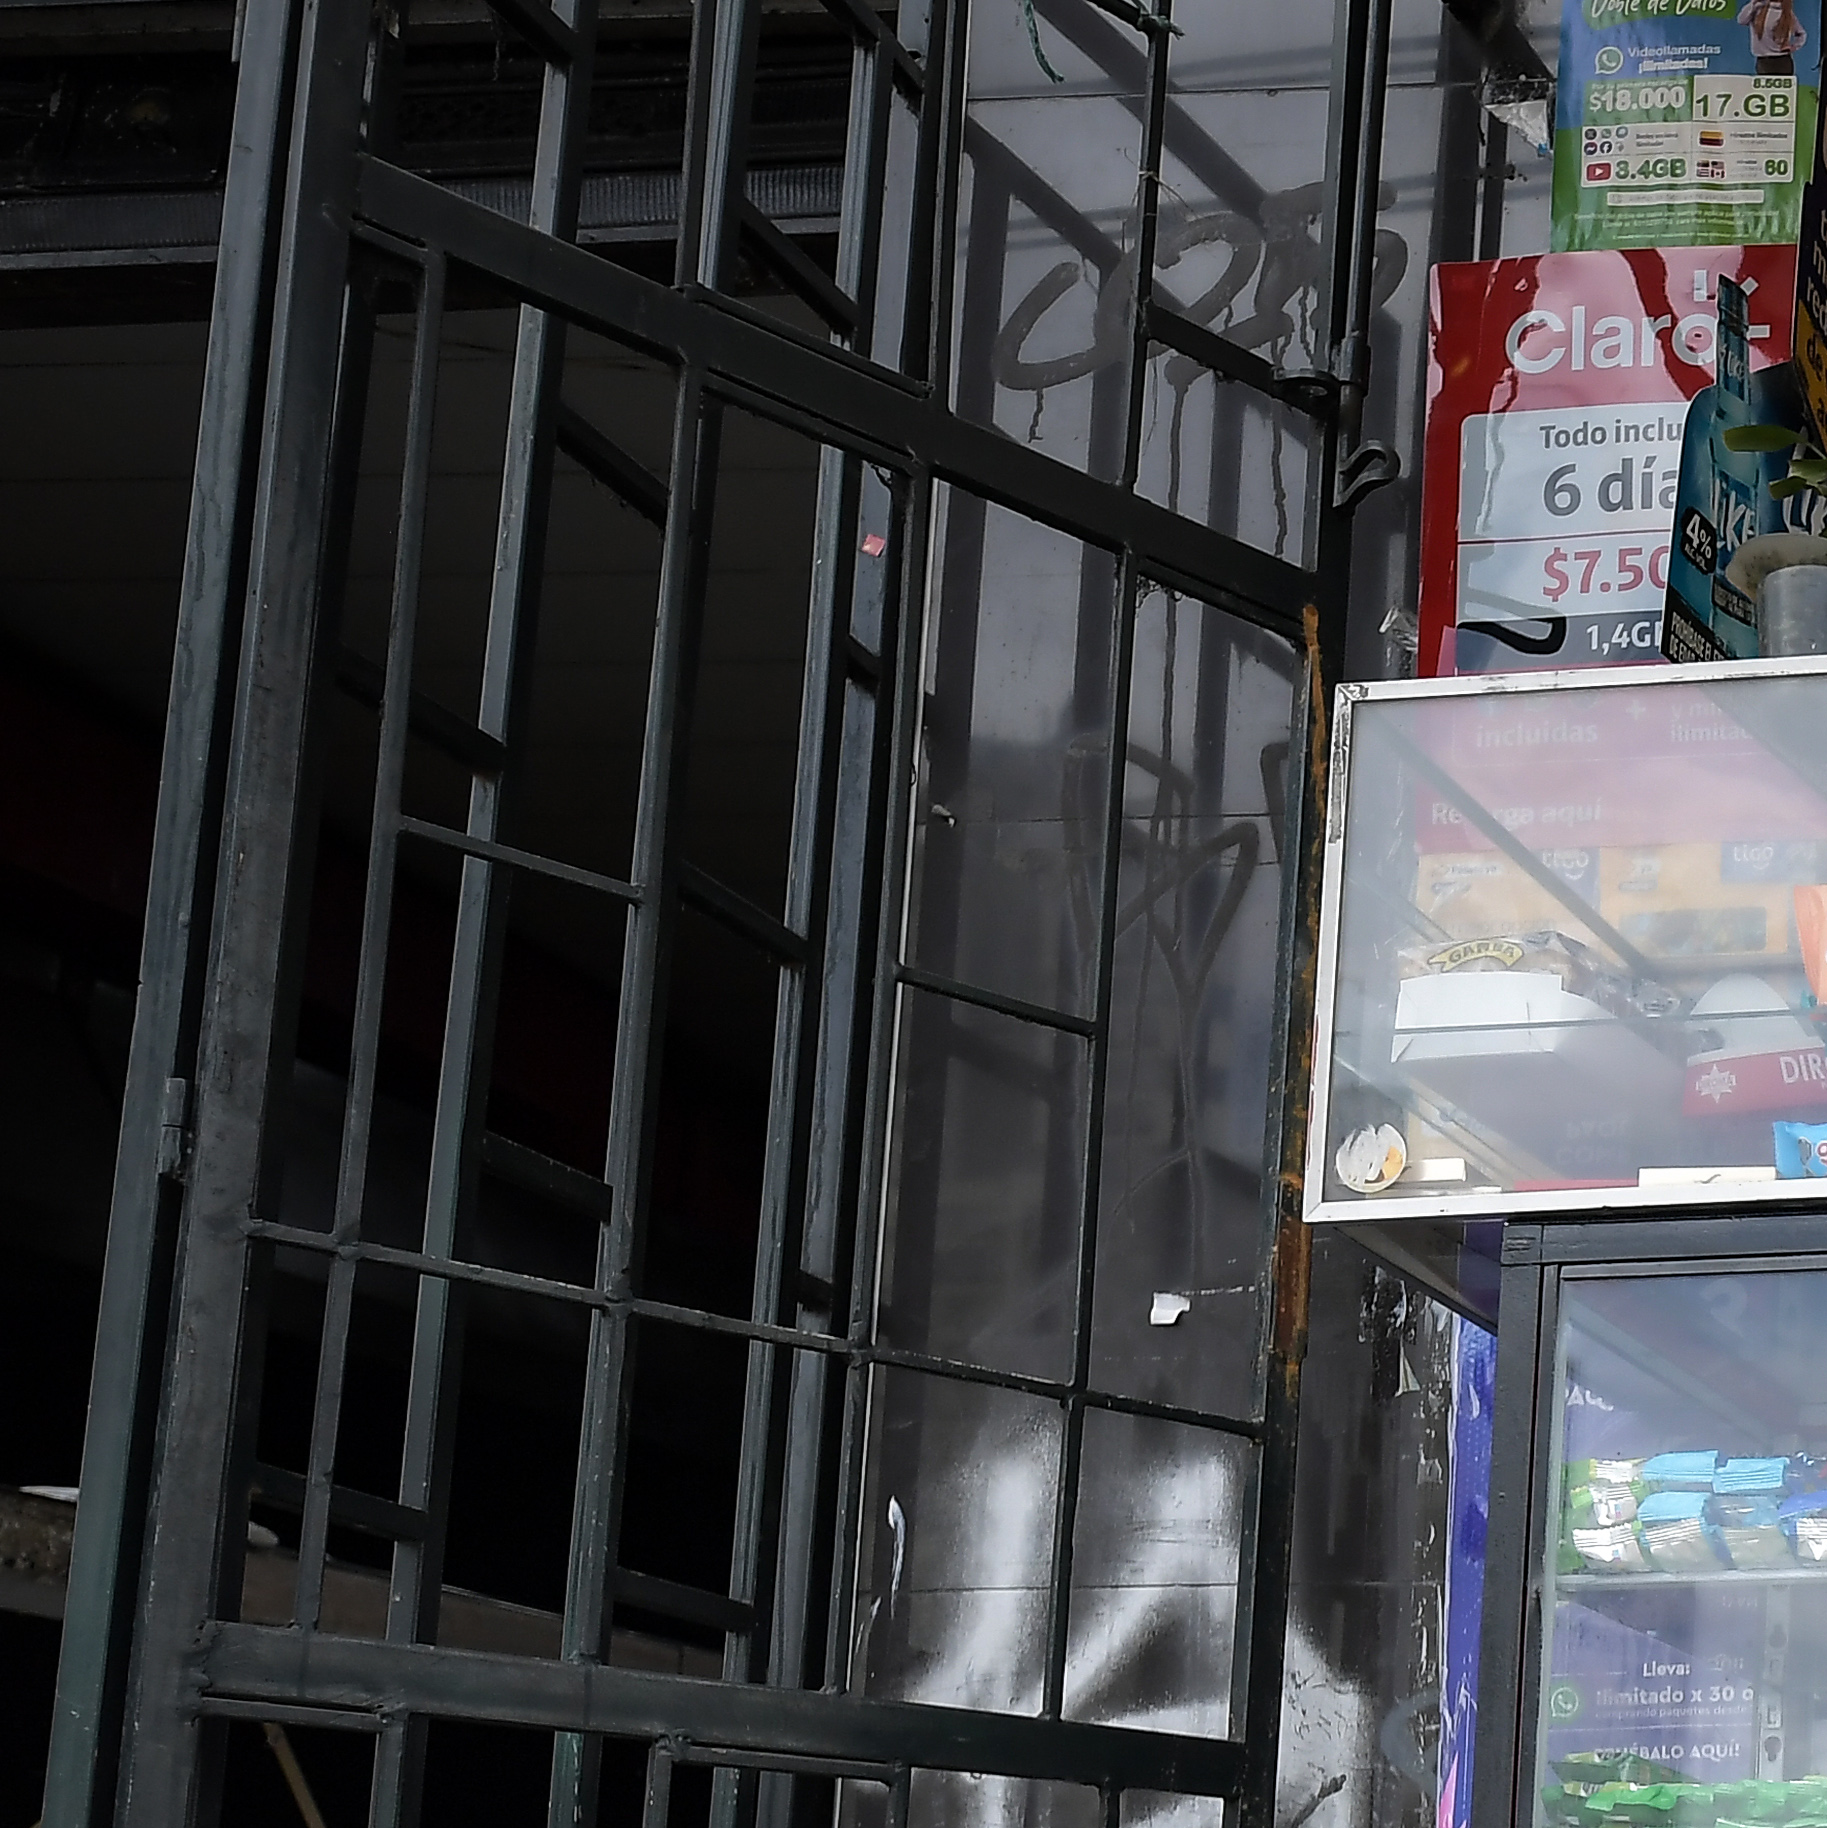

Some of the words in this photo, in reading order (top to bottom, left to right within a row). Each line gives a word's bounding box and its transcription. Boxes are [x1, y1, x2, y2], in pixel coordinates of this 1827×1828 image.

[1589, 86, 1685, 112] $18.000
[1695, 93, 1790, 117] 17.GB
[1615, 158, 1686, 179] 3.4GB
[1505, 305, 1716, 374] Claro
[1539, 422, 1607, 449] Todo
[1543, 463, 1581, 516] 6
[1686, 513, 1711, 560] 4%
[1475, 720, 1598, 748] incluidas
[1542, 797, 1601, 827] aquí
[1733, 840, 1773, 866] tigo
[1644, 1661, 1690, 1677] Lleva:
[1709, 1686, 1734, 1702] 30
